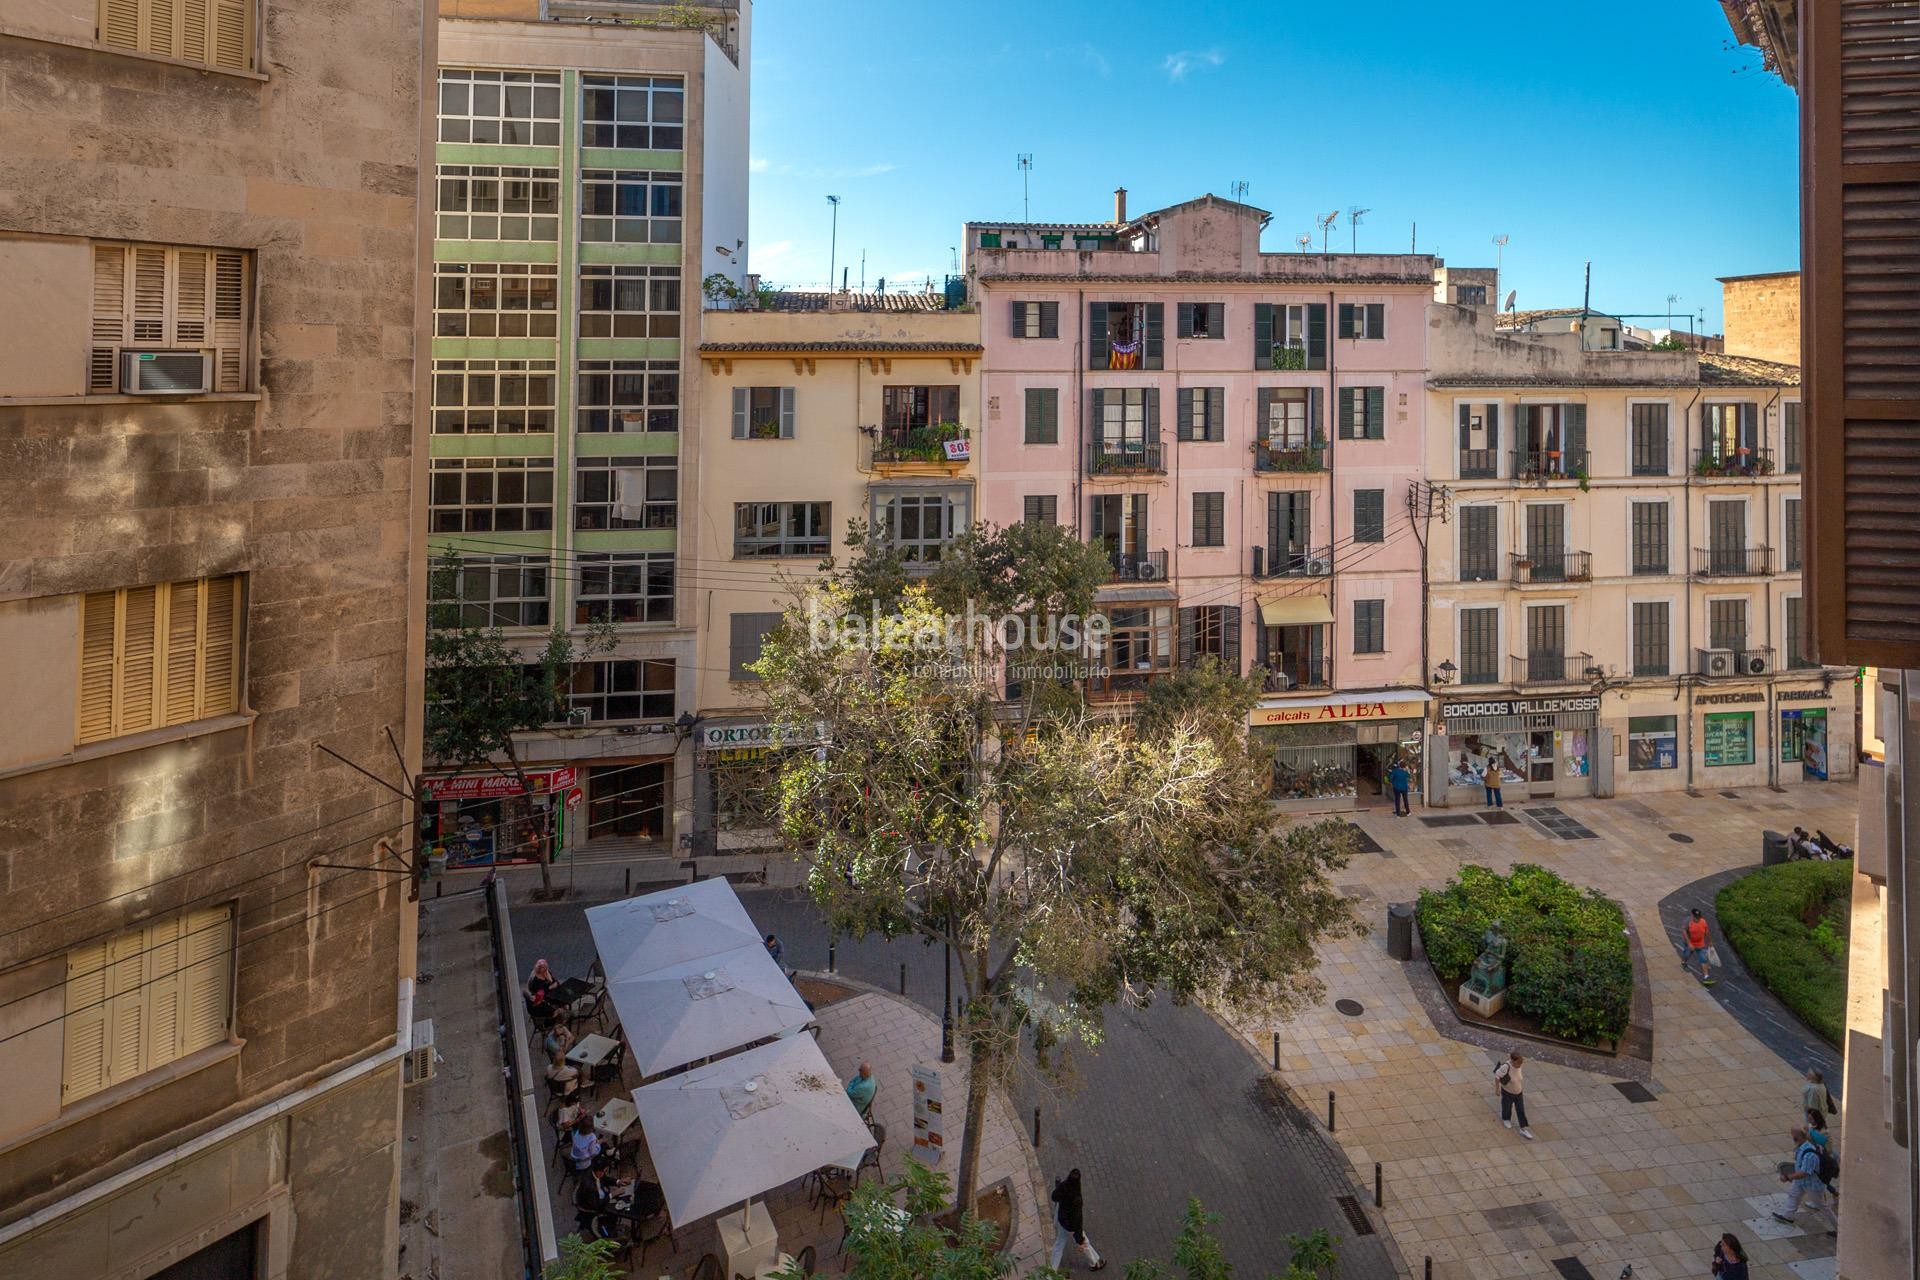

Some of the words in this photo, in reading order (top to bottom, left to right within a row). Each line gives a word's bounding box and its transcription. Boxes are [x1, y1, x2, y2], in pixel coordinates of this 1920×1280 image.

[1266, 710, 1310, 722] calçats
[1317, 702, 1389, 719] ALBA
[1443, 702, 1508, 717] BORDADOS
[1512, 698, 1600, 714] VALLDEMOSSA
[450, 779, 480, 790] MINI
[482, 777, 523, 788] MARKE
